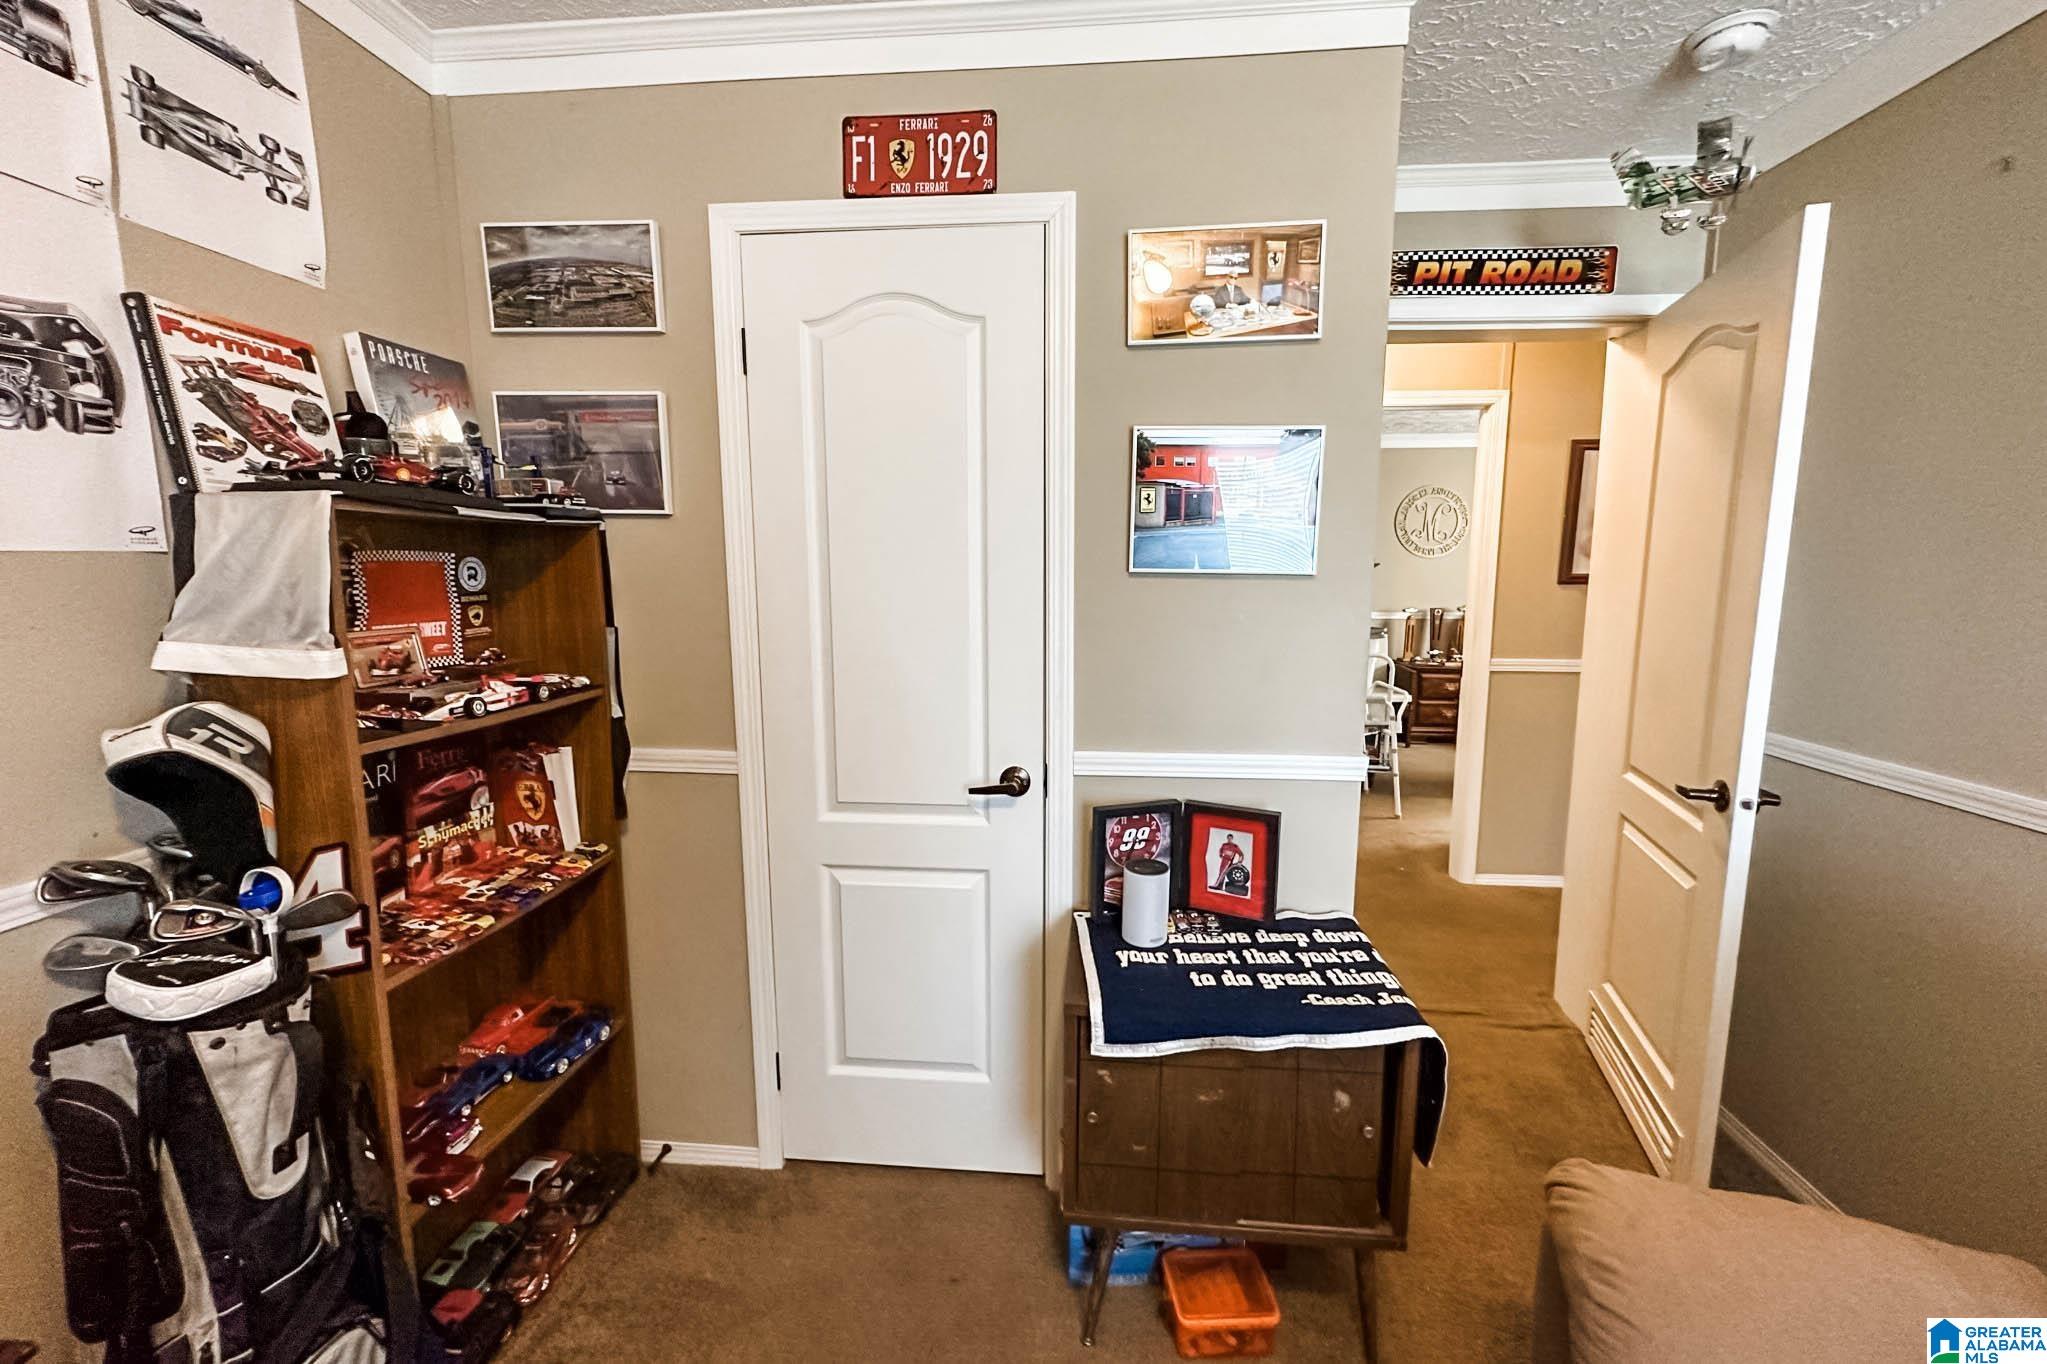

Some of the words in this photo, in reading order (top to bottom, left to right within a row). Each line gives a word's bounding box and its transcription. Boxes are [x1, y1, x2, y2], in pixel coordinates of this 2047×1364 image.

[899, 117, 938, 131] FERRARI
[852, 135, 875, 182] F1
[927, 130, 988, 180] 1929
[890, 183, 911, 194] ENZO
[915, 181, 949, 193] FERRARI
[1413, 260, 1473, 285] PIT
[1479, 259, 1583, 285] ROAD
[156, 313, 305, 371] Formula
[290, 347, 317, 374] 1
[367, 340, 430, 374] PORSCHE
[418, 810, 495, 849] Schumacer
[1254, 928, 1310, 948] deep
[1115, 950, 1169, 967] your
[1172, 948, 1240, 965] heart
[1241, 948, 1294, 965] that
[1295, 947, 1370, 968] you're
[1189, 970, 1216, 987] to
[1221, 970, 1254, 987] do
[1256, 970, 1327, 990] great
